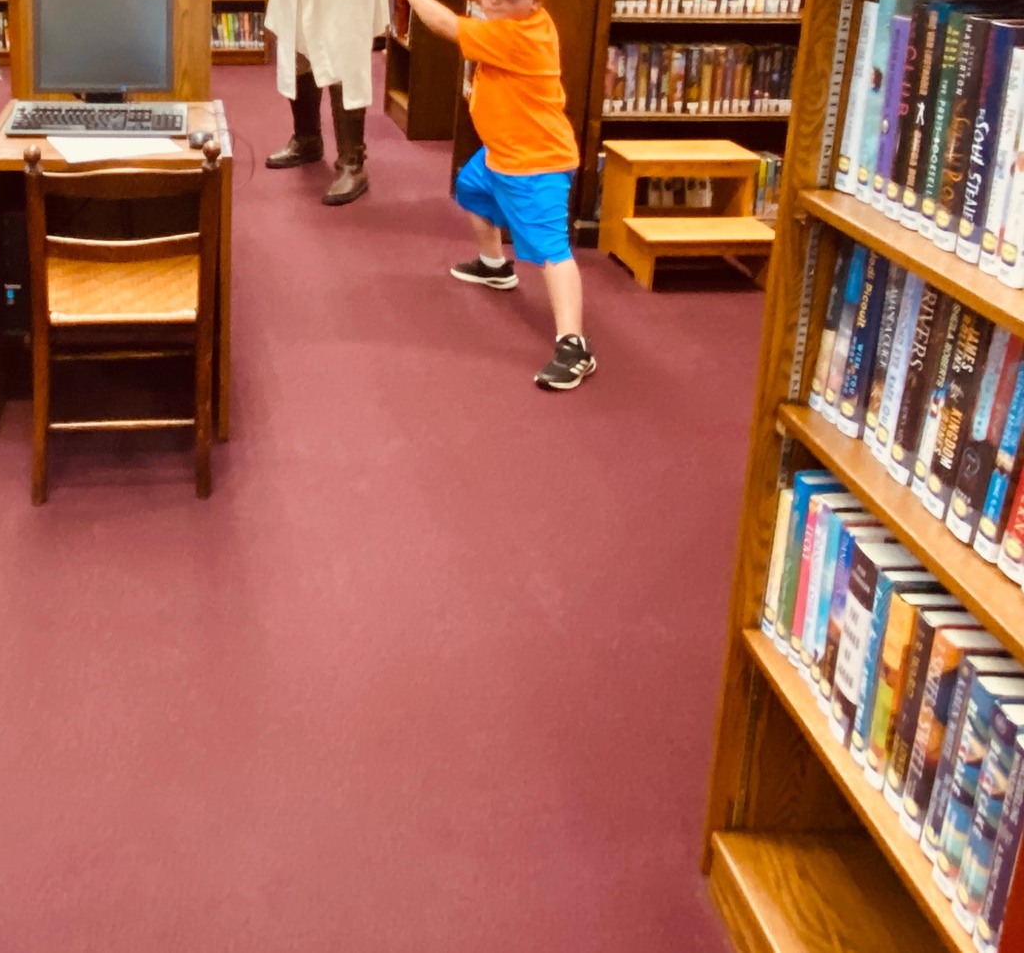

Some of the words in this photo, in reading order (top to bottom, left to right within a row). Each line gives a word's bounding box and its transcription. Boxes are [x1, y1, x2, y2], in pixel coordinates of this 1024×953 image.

[956, 23, 973, 96] MASTERTON
[926, 137, 941, 195] BOOKSELL
[857, 282, 873, 328] Picoult
[910, 290, 937, 371] RIVERS
[961, 326, 980, 373] JAMES
[939, 407, 963, 470] KINGDOM
[802, 525, 814, 560] LUCKY
[910, 720, 932, 778] SWEET
